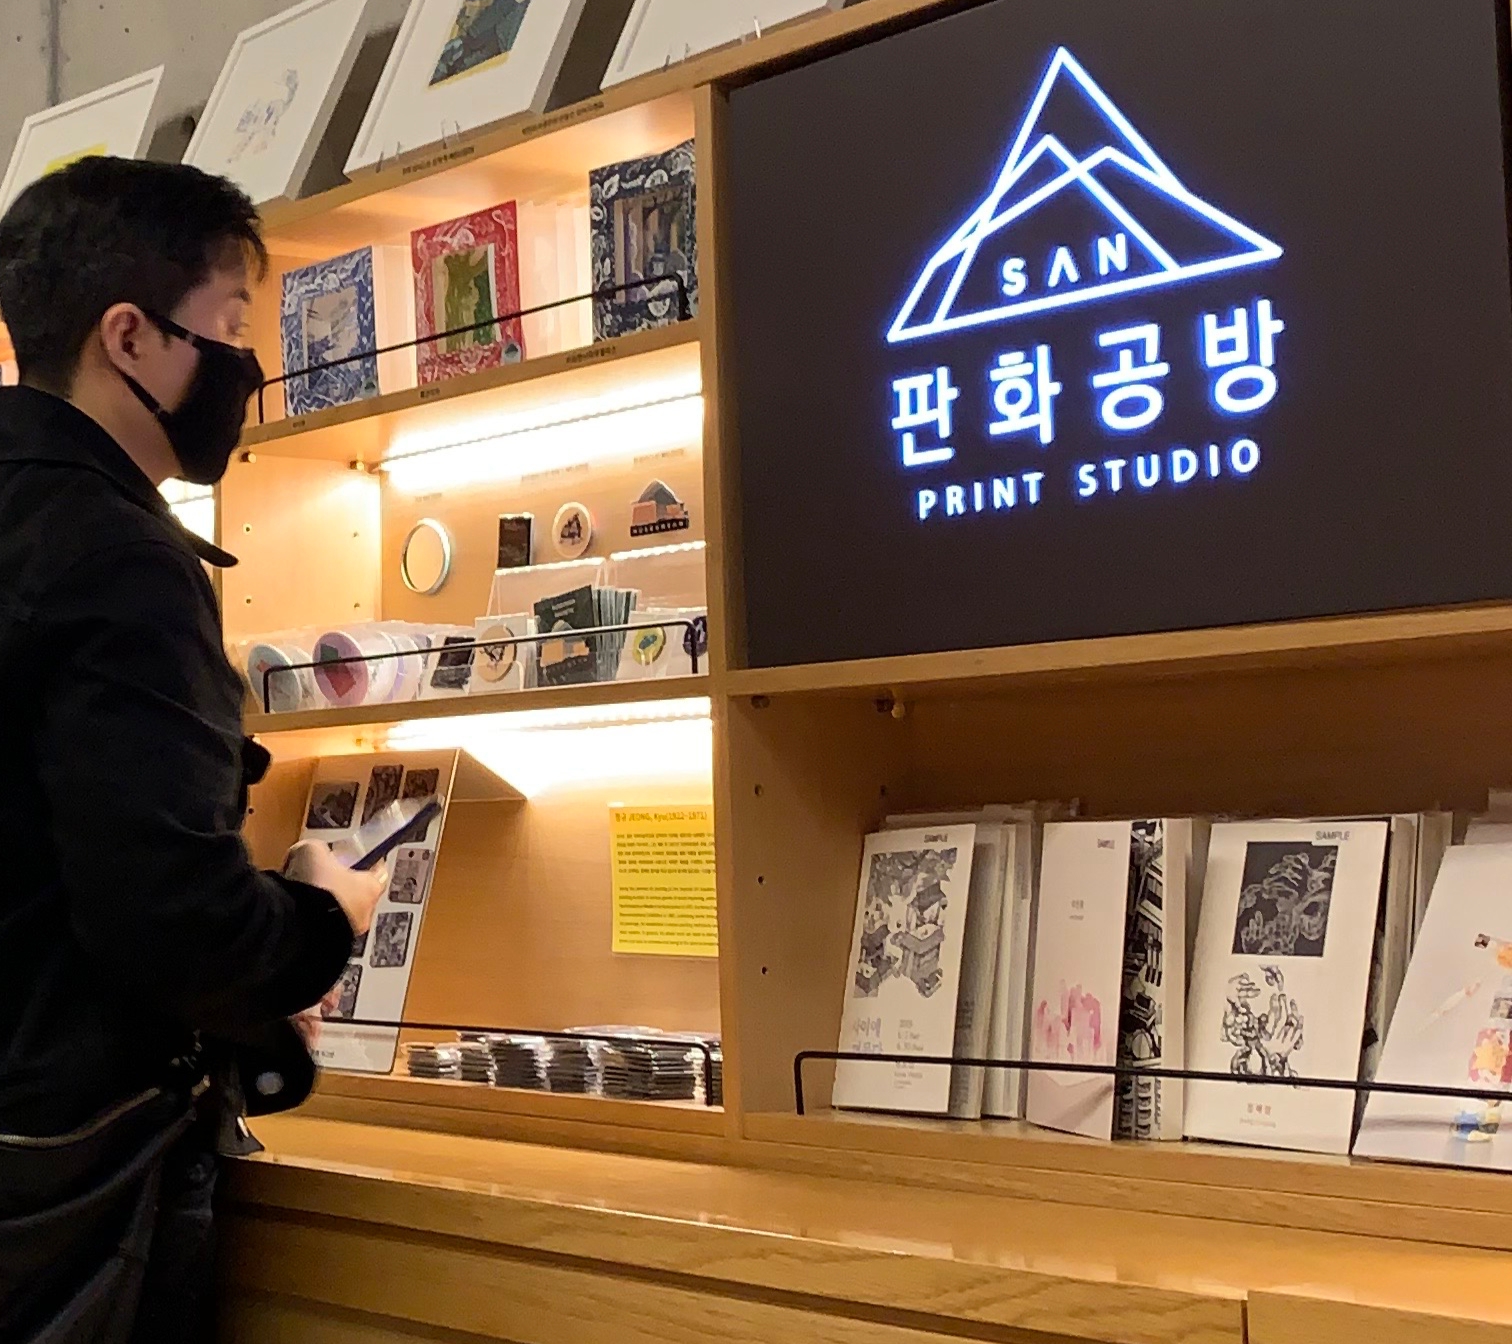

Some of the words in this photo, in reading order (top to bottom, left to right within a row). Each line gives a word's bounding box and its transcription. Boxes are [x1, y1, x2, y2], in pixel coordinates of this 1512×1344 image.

[1001, 232, 1128, 297] SAN
[890, 299, 1285, 467] 판화공방
[918, 471, 1045, 520] PRINT
[1078, 438, 1261, 497] STUDIO
